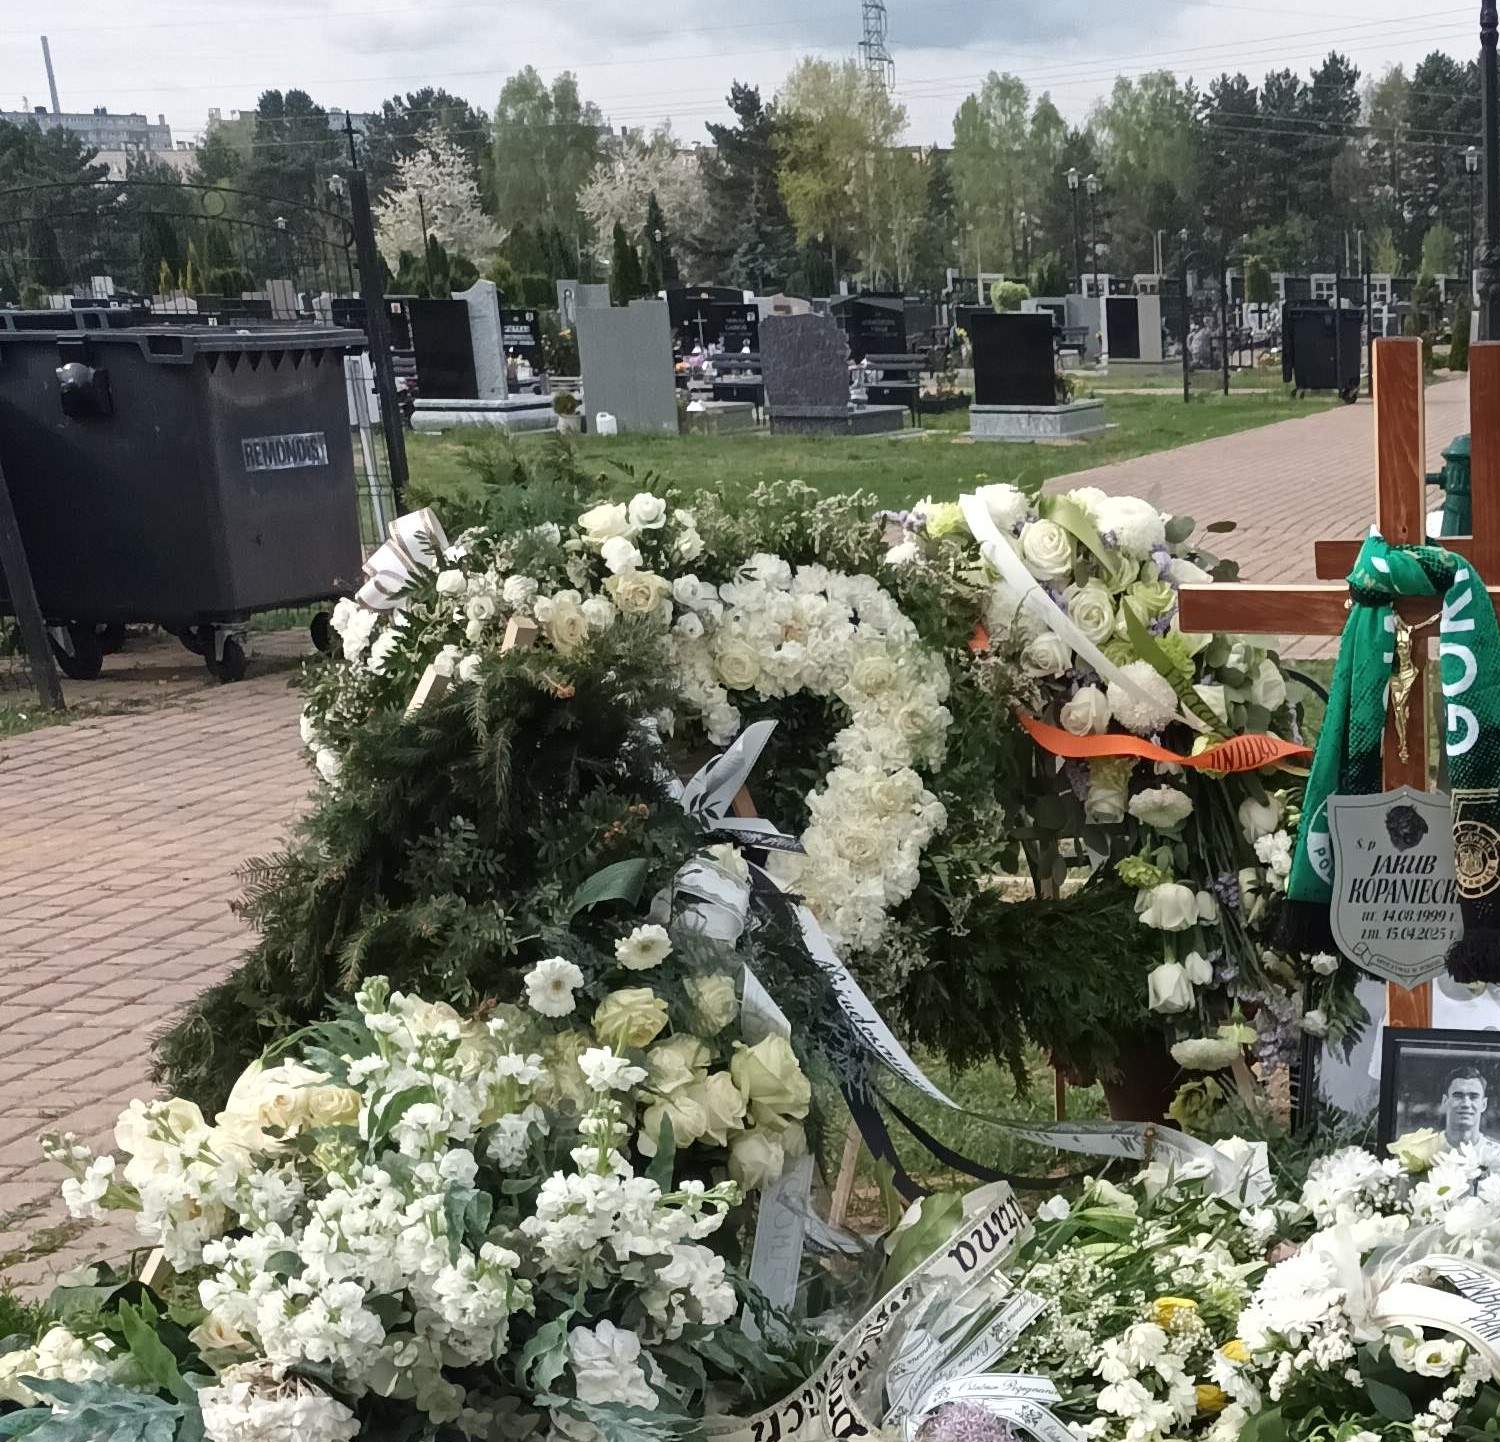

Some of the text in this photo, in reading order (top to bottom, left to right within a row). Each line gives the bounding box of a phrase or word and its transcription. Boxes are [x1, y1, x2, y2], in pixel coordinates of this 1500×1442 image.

[1370, 855, 1437, 875] JAKUB
[1348, 878, 1459, 904] KOPANIECK
[1382, 909, 1446, 922] 14.08.1999
